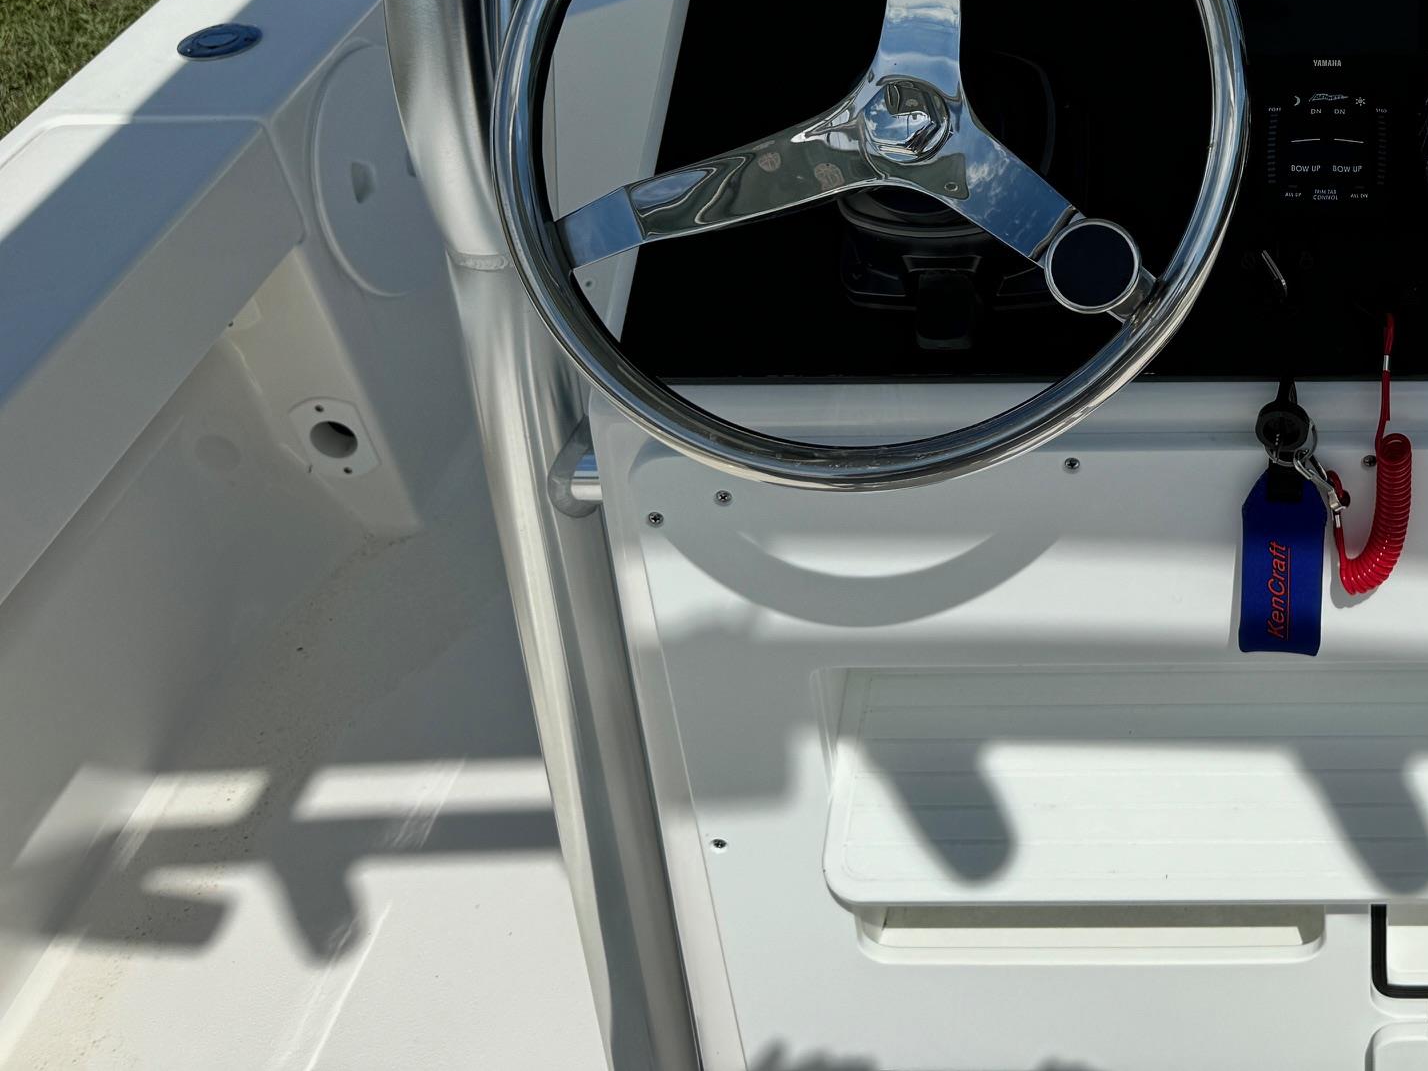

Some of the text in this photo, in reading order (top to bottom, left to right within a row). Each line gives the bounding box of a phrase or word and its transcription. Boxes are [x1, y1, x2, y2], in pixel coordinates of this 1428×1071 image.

[1312, 59, 1342, 67] YAMAHA
[1290, 164, 1321, 172] BOW UP
[1332, 164, 1363, 173] BOW UP
[1266, 539, 1287, 639] KenCraft
